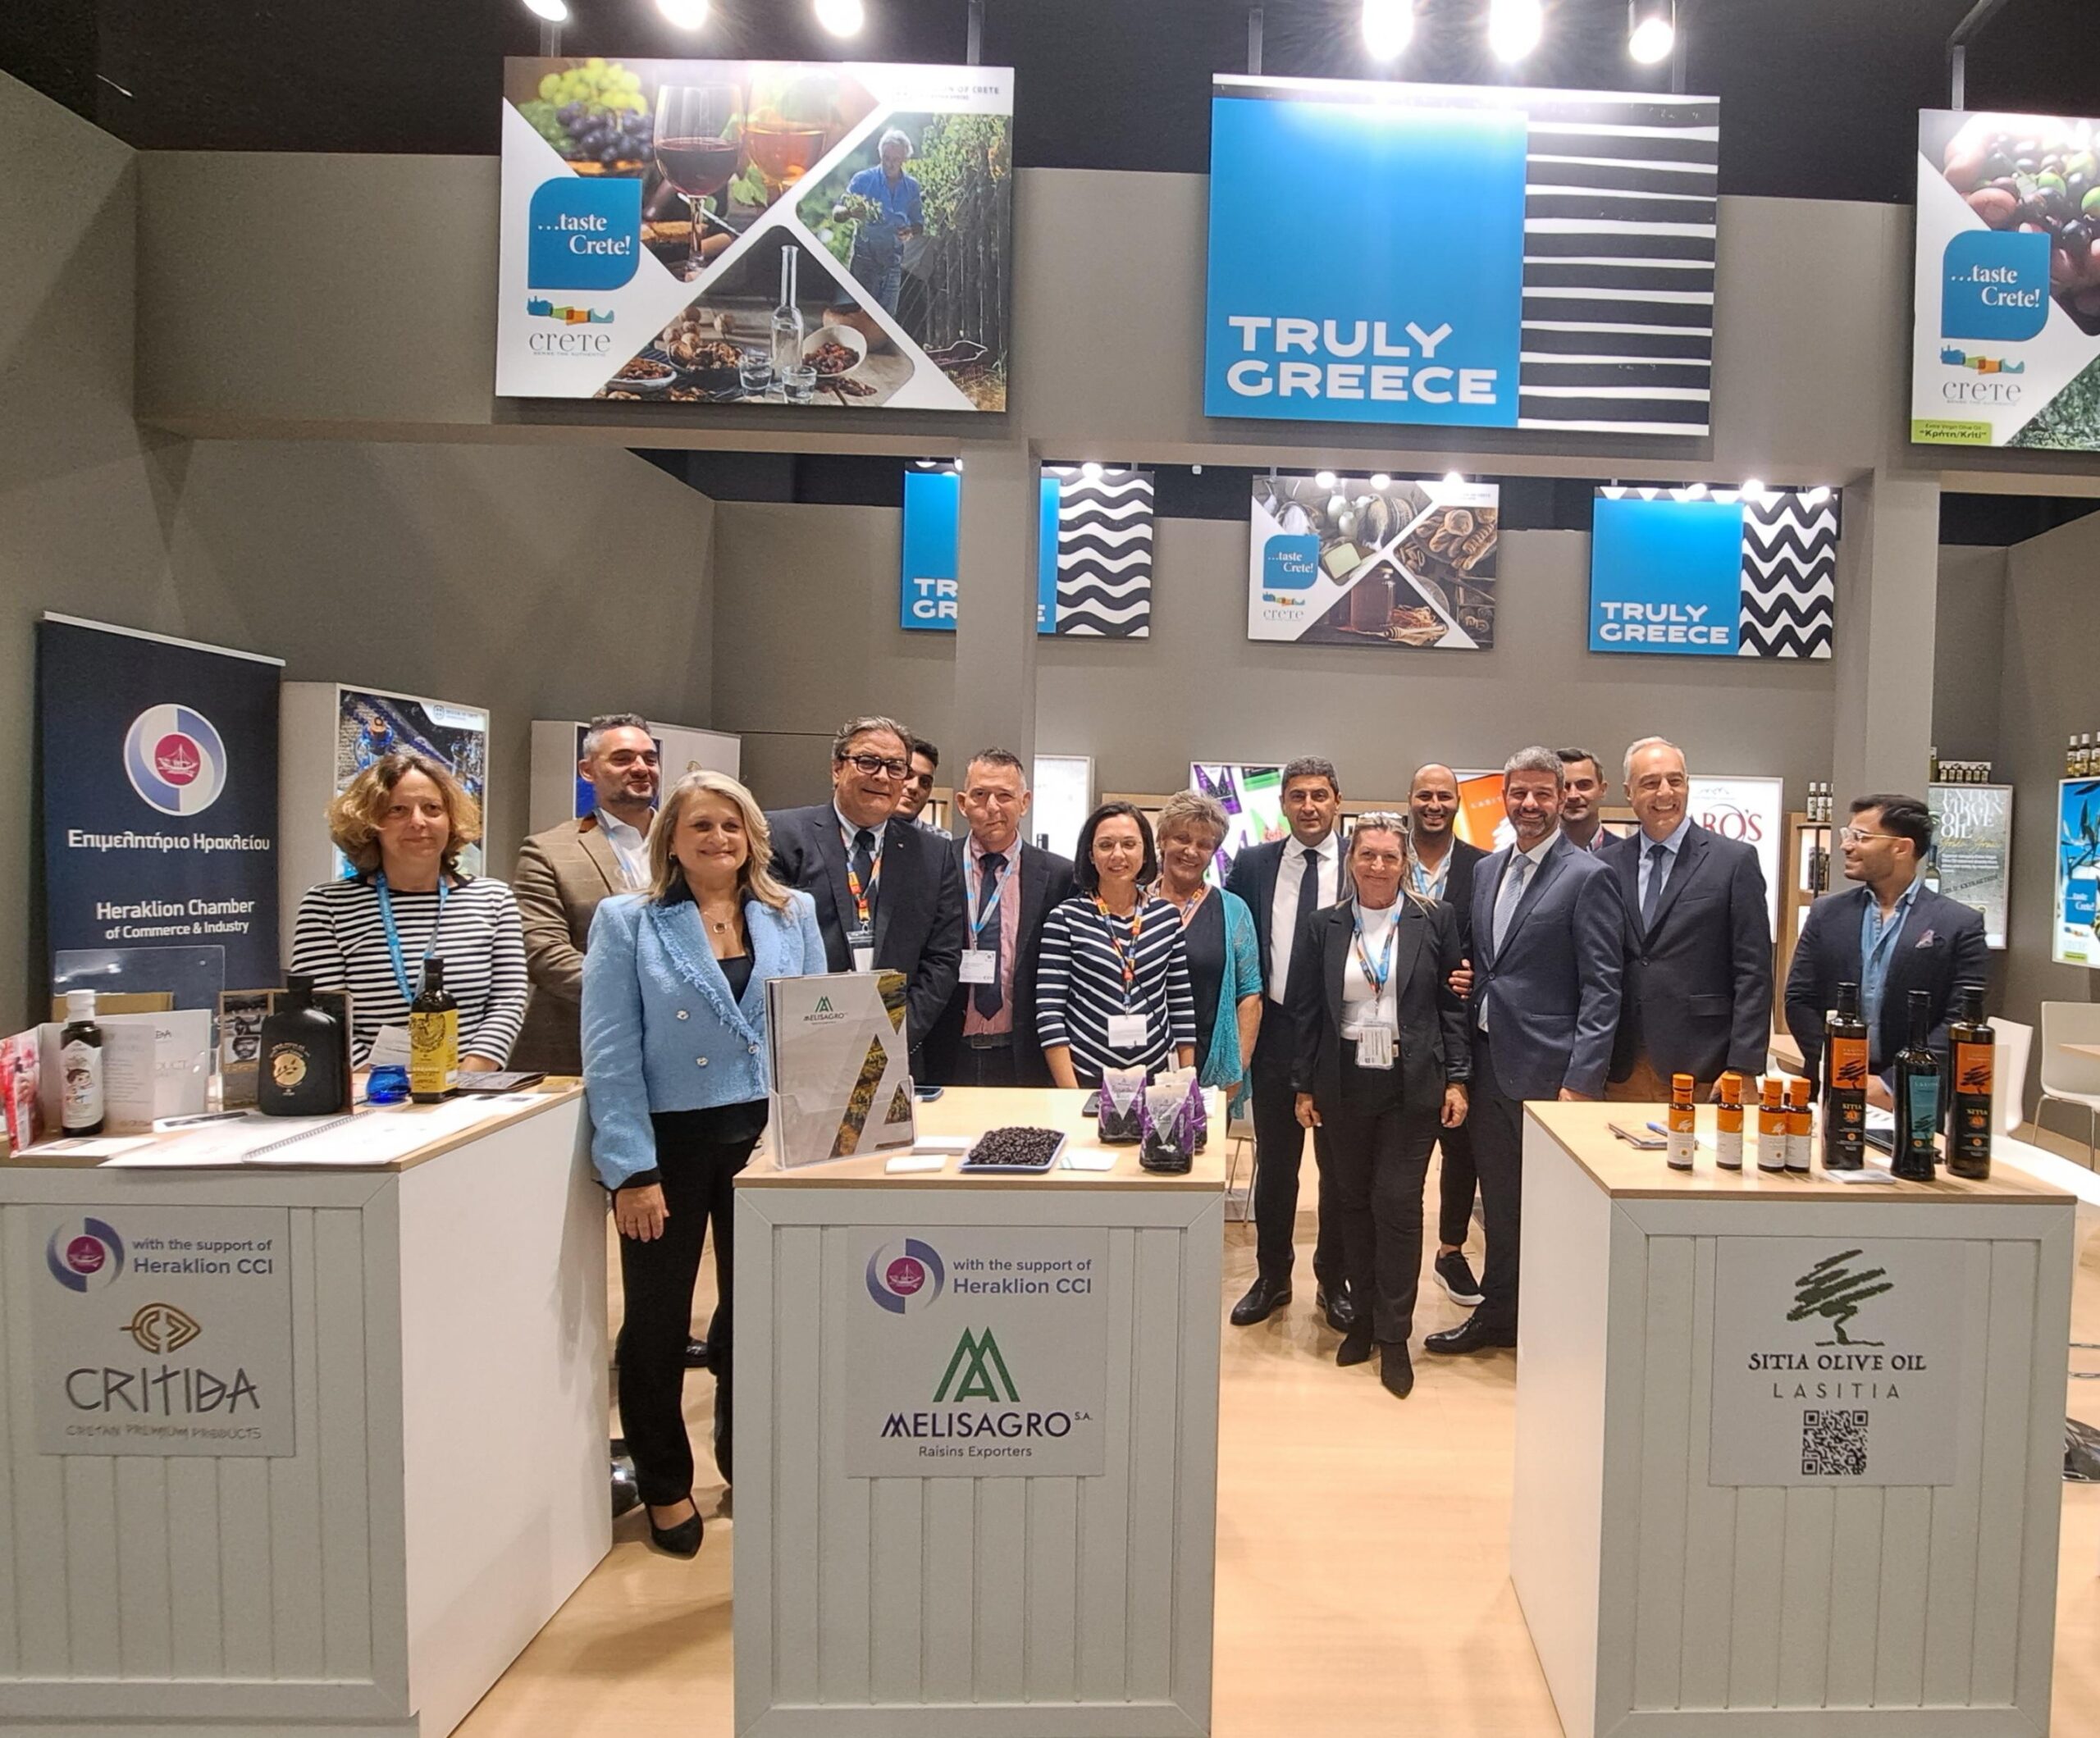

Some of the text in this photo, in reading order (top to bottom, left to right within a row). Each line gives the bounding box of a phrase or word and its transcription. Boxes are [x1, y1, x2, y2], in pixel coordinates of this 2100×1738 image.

[569, 235, 631, 255] Crete!
[1981, 286, 2040, 308] Crete!
[1228, 315, 1453, 358] TRULY
[1226, 359, 1498, 405] GREECE
[1283, 563, 1314, 573] Crete!
[1600, 602, 1709, 623] TRULY
[1600, 623, 1729, 645] GREECE
[1942, 800, 2006, 814] VIRGIN
[1941, 812, 1995, 828] OLIVE
[1941, 823, 1973, 839] OIL
[68, 829, 270, 853] Επιμελητήριο Ηρακλείου
[97, 898, 255, 919] Heraklion Chamber
[105, 920, 250, 940] of Commerce & Industry
[133, 1238, 272, 1253] with the support of
[134, 1257, 273, 1275] Heraklion CCI
[953, 1259, 1092, 1273] with the support of
[953, 1278, 1092, 1293] Heraklion CCI
[1748, 1353, 1927, 1371] SITIA OLIVE OIL
[66, 1424, 262, 1439] CRETAN PREMIUM PRODUCTS
[880, 1412, 1093, 1438] MELISAGRO S.A.
[919, 1446, 1033, 1459] Raisins Exporters
